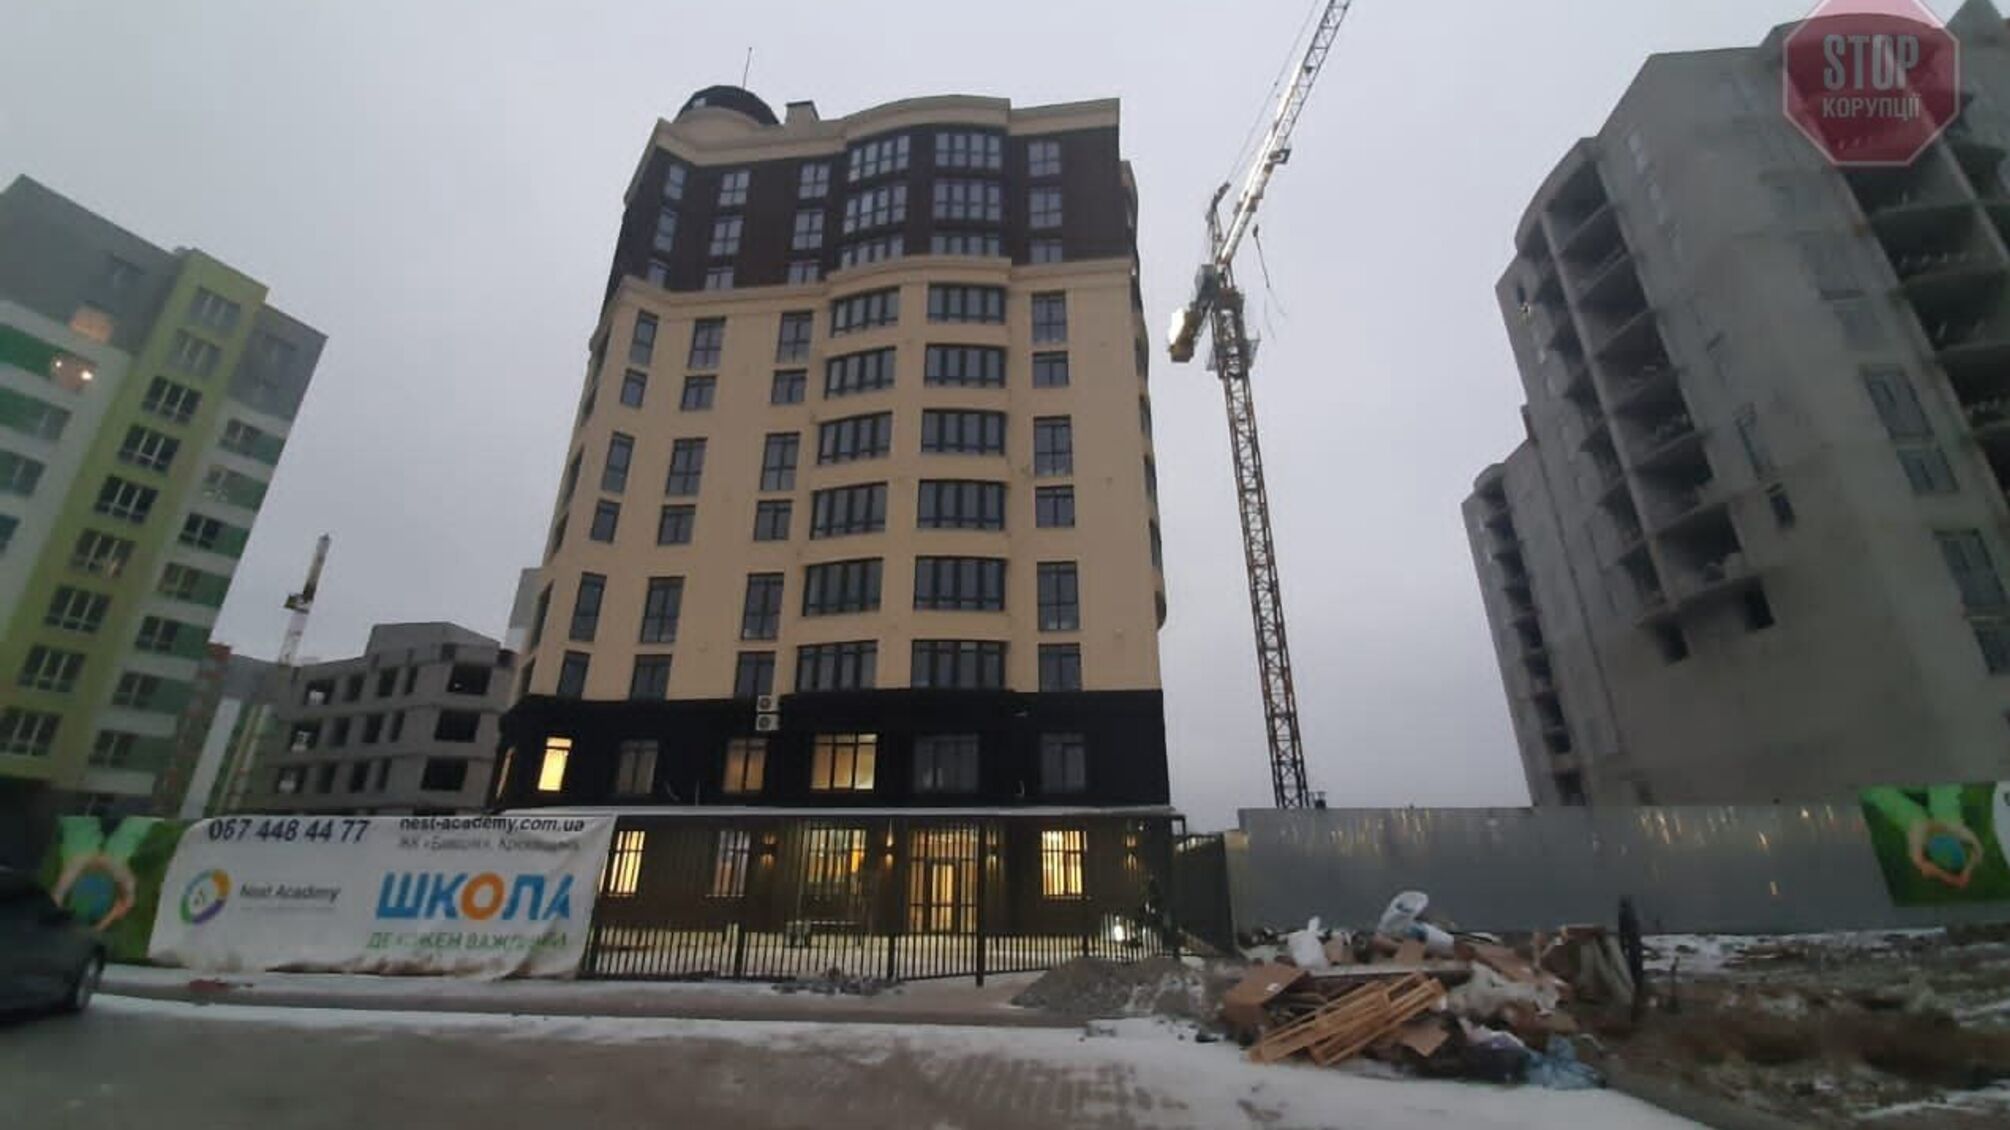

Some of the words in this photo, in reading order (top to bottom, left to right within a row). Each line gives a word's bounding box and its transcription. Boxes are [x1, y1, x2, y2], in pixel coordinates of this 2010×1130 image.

[207, 818, 252, 841] 067
[255, 819, 300, 842] 448
[304, 819, 334, 841] 44
[341, 819, 371, 843] 77
[375, 871, 574, 921] ШКОЛА
